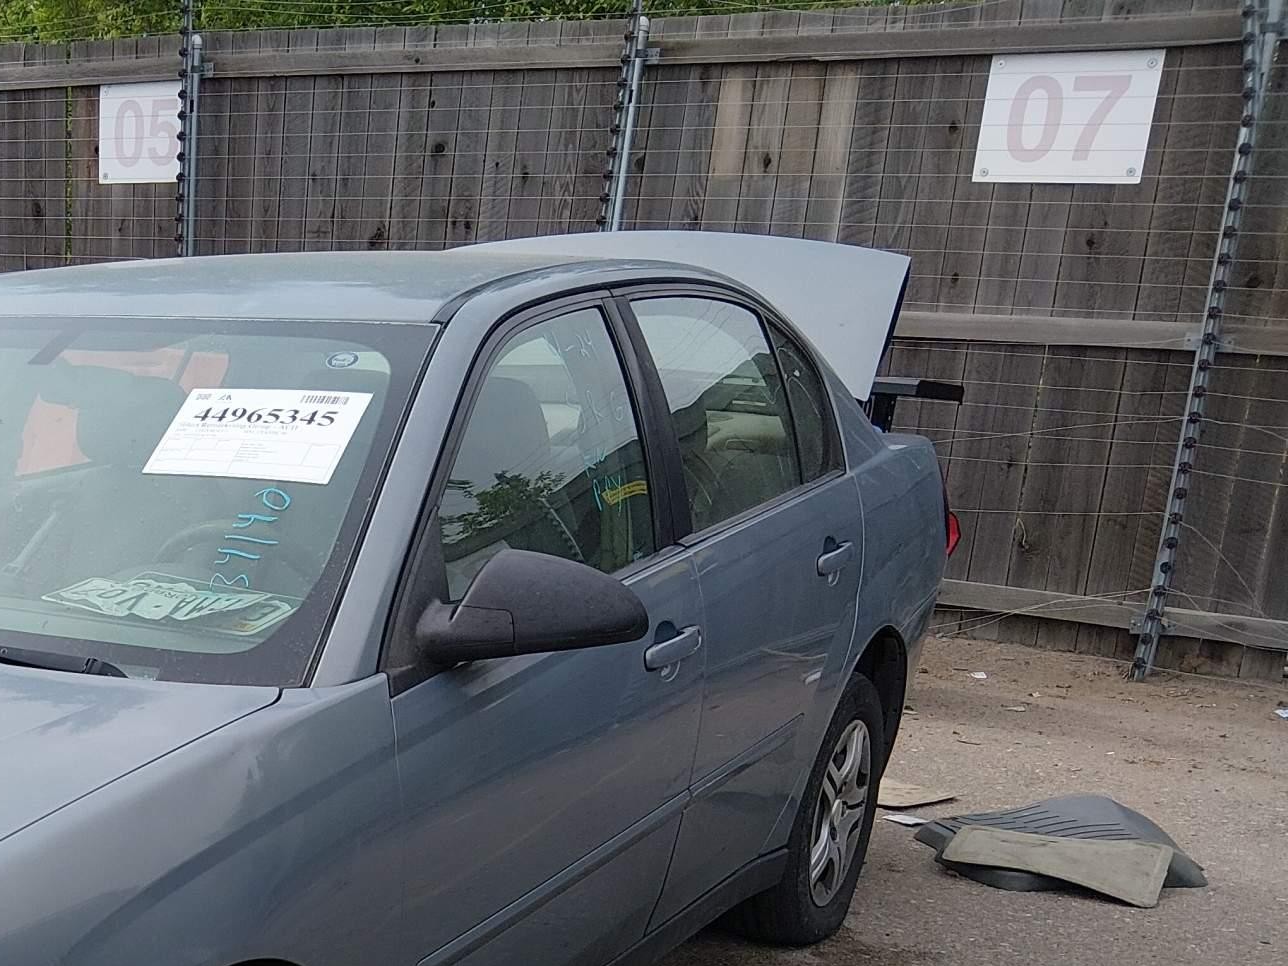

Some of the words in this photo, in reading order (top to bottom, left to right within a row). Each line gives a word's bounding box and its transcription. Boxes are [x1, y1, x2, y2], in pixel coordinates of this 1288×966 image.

[114, 98, 179, 168] 05
[1006, 74, 1133, 163] 07
[193, 407, 339, 427] 44965345
